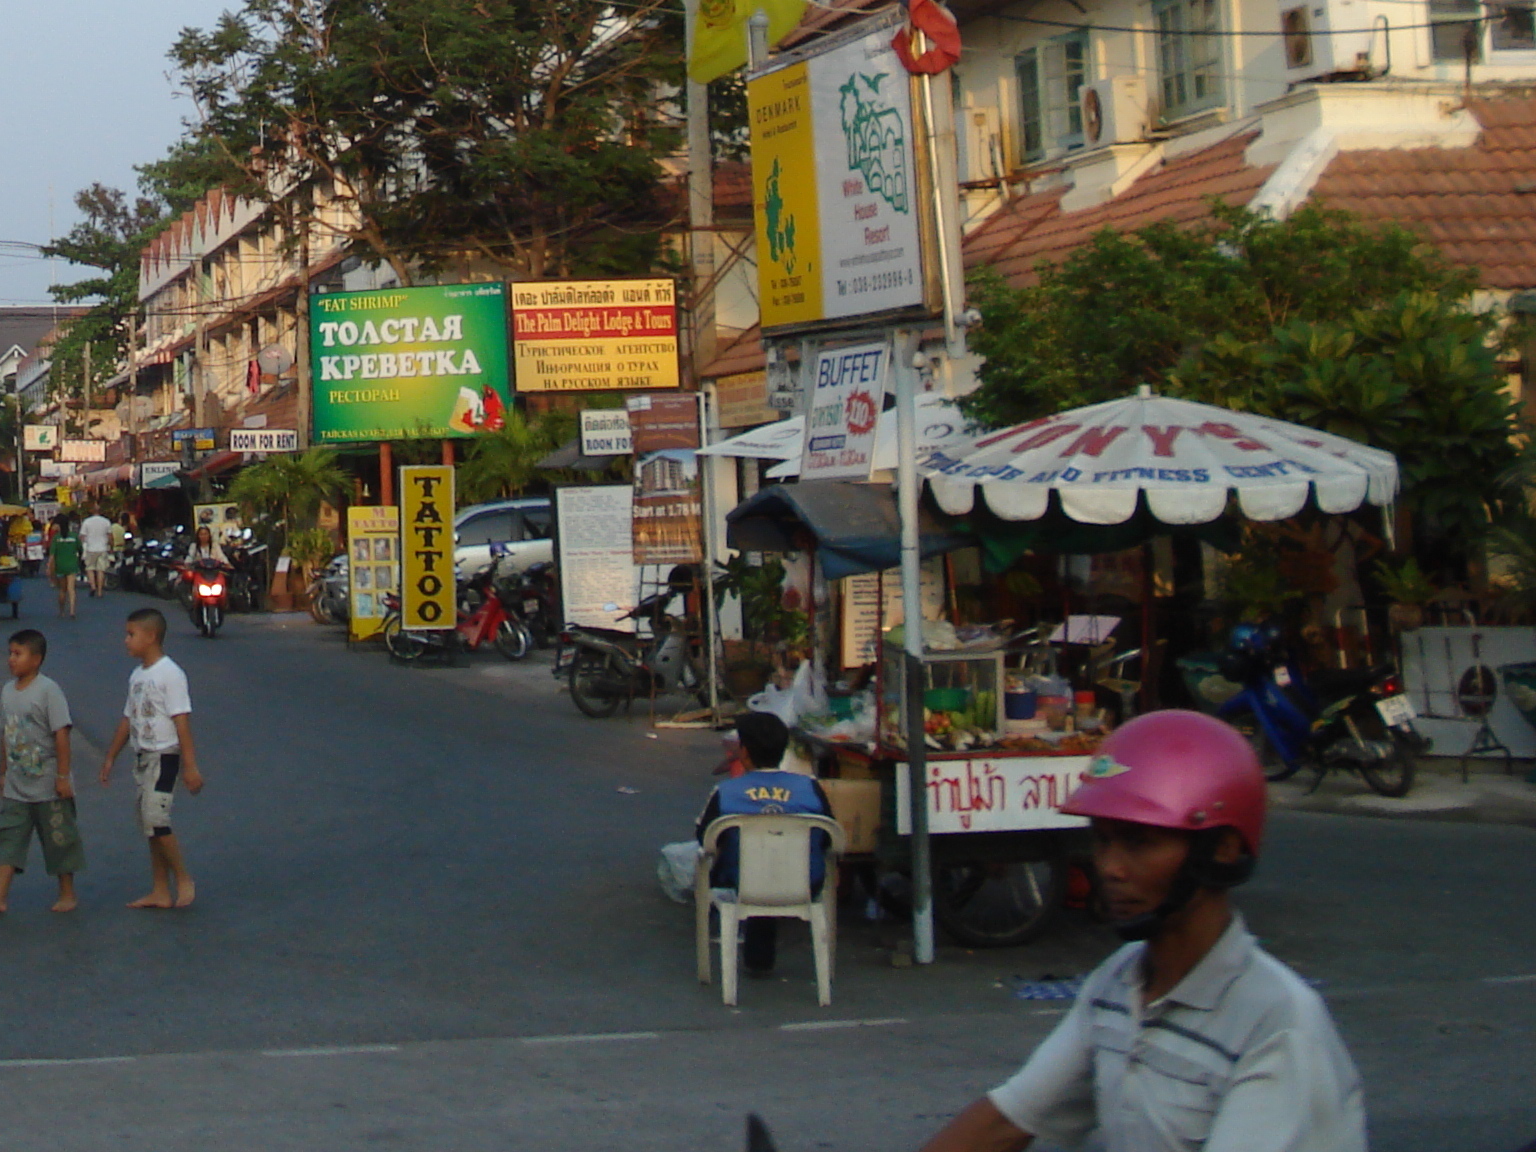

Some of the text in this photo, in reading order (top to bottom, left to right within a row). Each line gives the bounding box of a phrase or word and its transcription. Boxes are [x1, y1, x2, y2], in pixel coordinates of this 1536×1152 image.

[855, 202, 878, 221] House
[865, 225, 890, 246] Resort
[319, 315, 463, 347] ТОЛСТАЯ
[516, 309, 672, 337] The Palm Delight Lodge & Tours
[320, 349, 482, 381] КРЕВЕТКА
[628, 361, 660, 373] ТУРАХ
[818, 350, 883, 389] BUFFET
[544, 376, 652, 389] НА РУССКОМ ЯЗЫКЕ
[329, 389, 400, 404] РЕСТОРАН
[233, 434, 295, 448] ROOM FOR RENT
[586, 439, 613, 451] ROOM
[1092, 466, 1211, 483] FITNESS
[413, 476, 443, 623] TATTOO
[745, 786, 791, 803] TAXI
